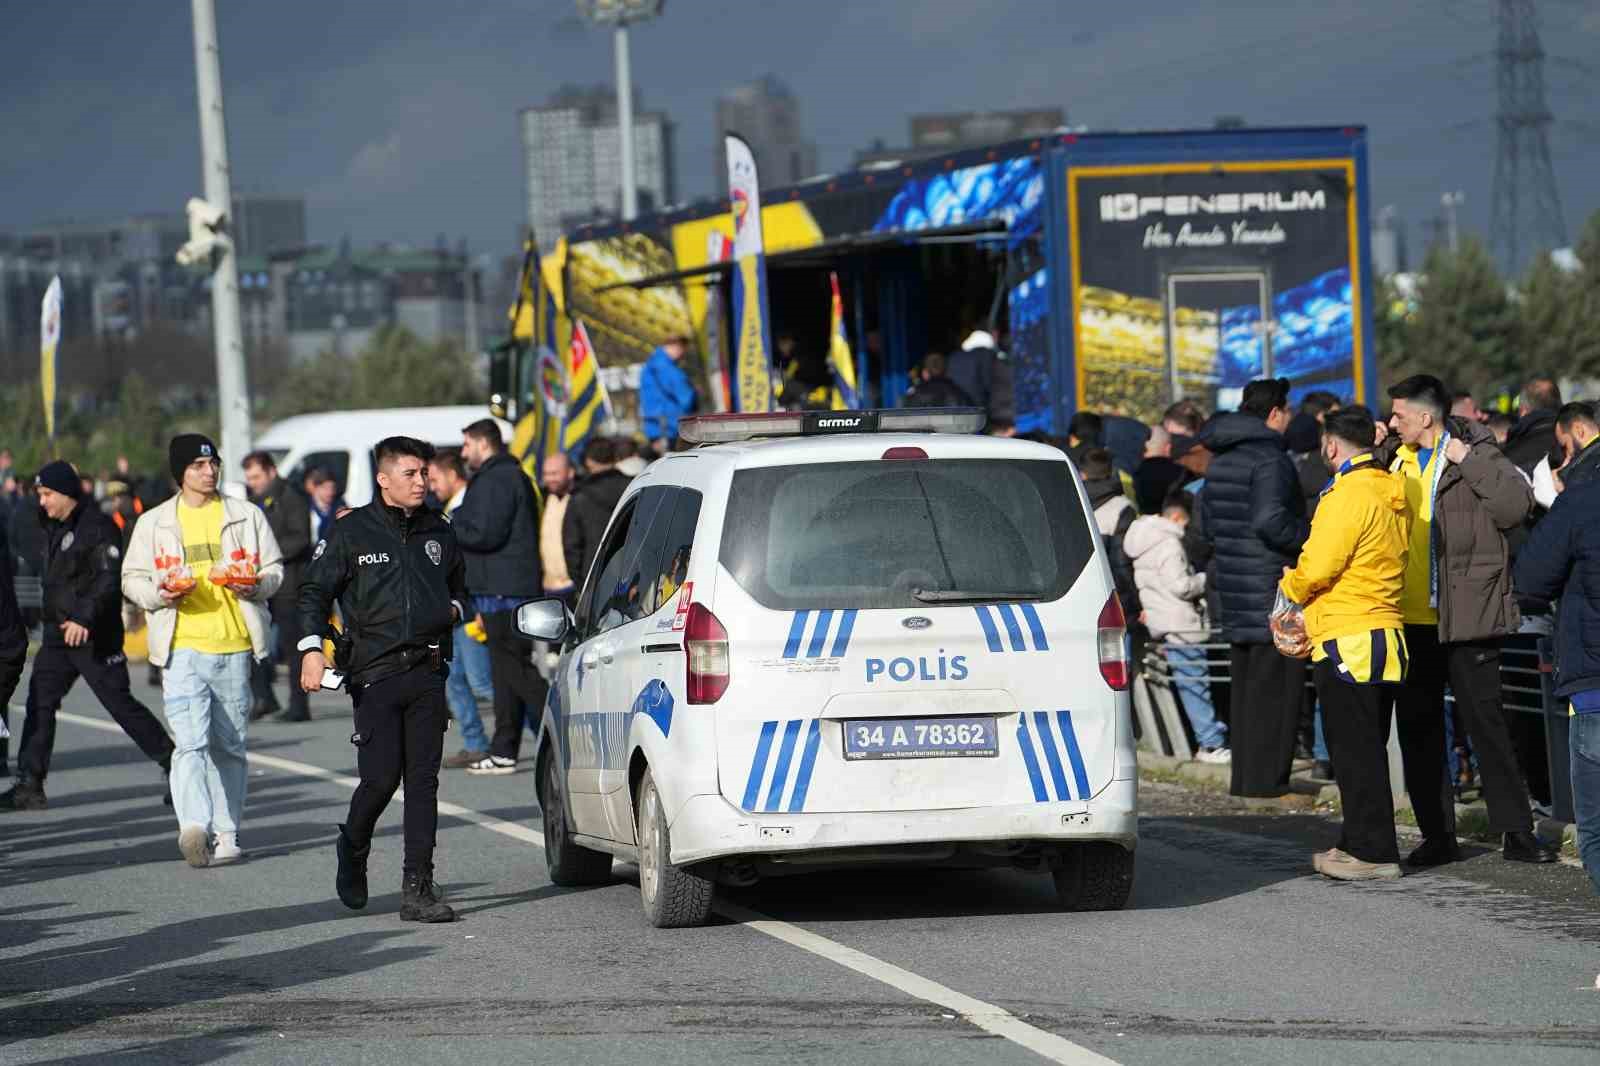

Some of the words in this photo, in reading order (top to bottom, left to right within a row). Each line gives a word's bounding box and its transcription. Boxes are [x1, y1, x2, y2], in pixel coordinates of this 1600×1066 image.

[1140, 191, 1327, 216] FENERIUM
[818, 418, 861, 428] armas
[866, 648, 969, 682] POLİS
[858, 725, 885, 747] 34
[892, 726, 909, 746] A
[914, 723, 985, 745] 78362
